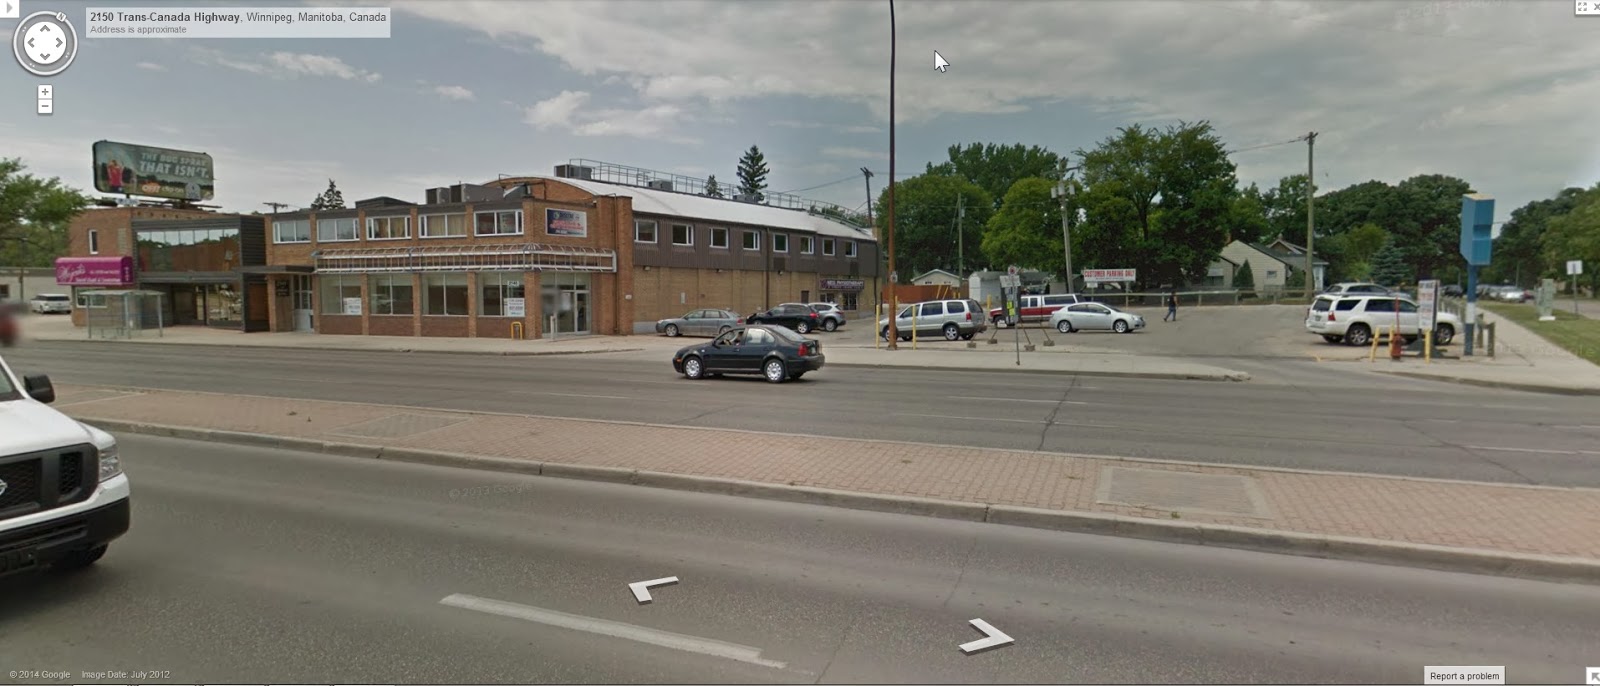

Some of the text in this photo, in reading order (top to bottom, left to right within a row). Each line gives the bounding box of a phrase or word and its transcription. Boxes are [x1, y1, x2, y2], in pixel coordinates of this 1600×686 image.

[142, 152, 206, 166] THE BUG SPRAY
[140, 161, 209, 178] THAT ISN'T.
